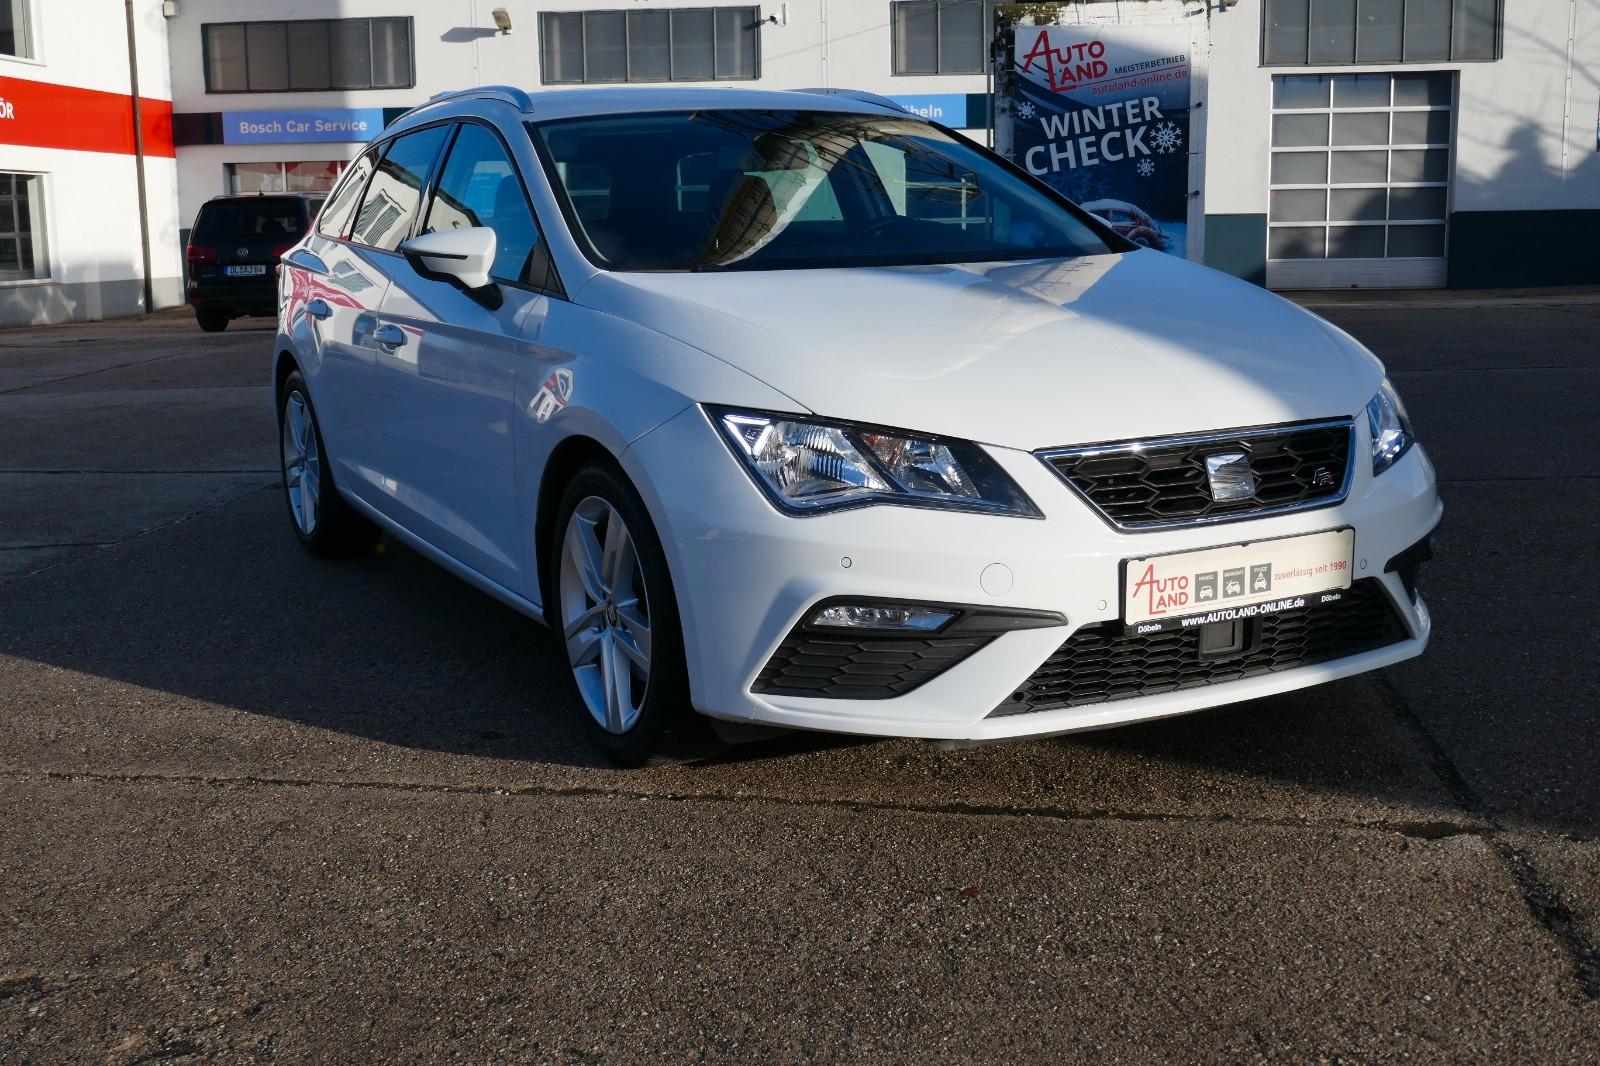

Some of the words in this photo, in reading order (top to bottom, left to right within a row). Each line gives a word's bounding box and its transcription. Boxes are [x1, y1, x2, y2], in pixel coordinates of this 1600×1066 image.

[1114, 54, 1186, 75] MEISTERBETRIEB
[1091, 69, 1188, 96] autoland-online.de
[239, 121, 282, 134] Bosch
[286, 120, 310, 133] Car
[315, 119, 368, 132] Service
[1040, 96, 1164, 140] WINTER
[1025, 125, 1152, 176] CHECK
[1133, 564, 1188, 598] AUTO
[1274, 568, 1313, 581] zuverlässig
[1315, 563, 1328, 574] seit
[1330, 560, 1347, 572] 1990
[1181, 597, 1305, 627] www.AUTOLAND-ONLINE.de
[1138, 623, 1162, 634] Döbeln
